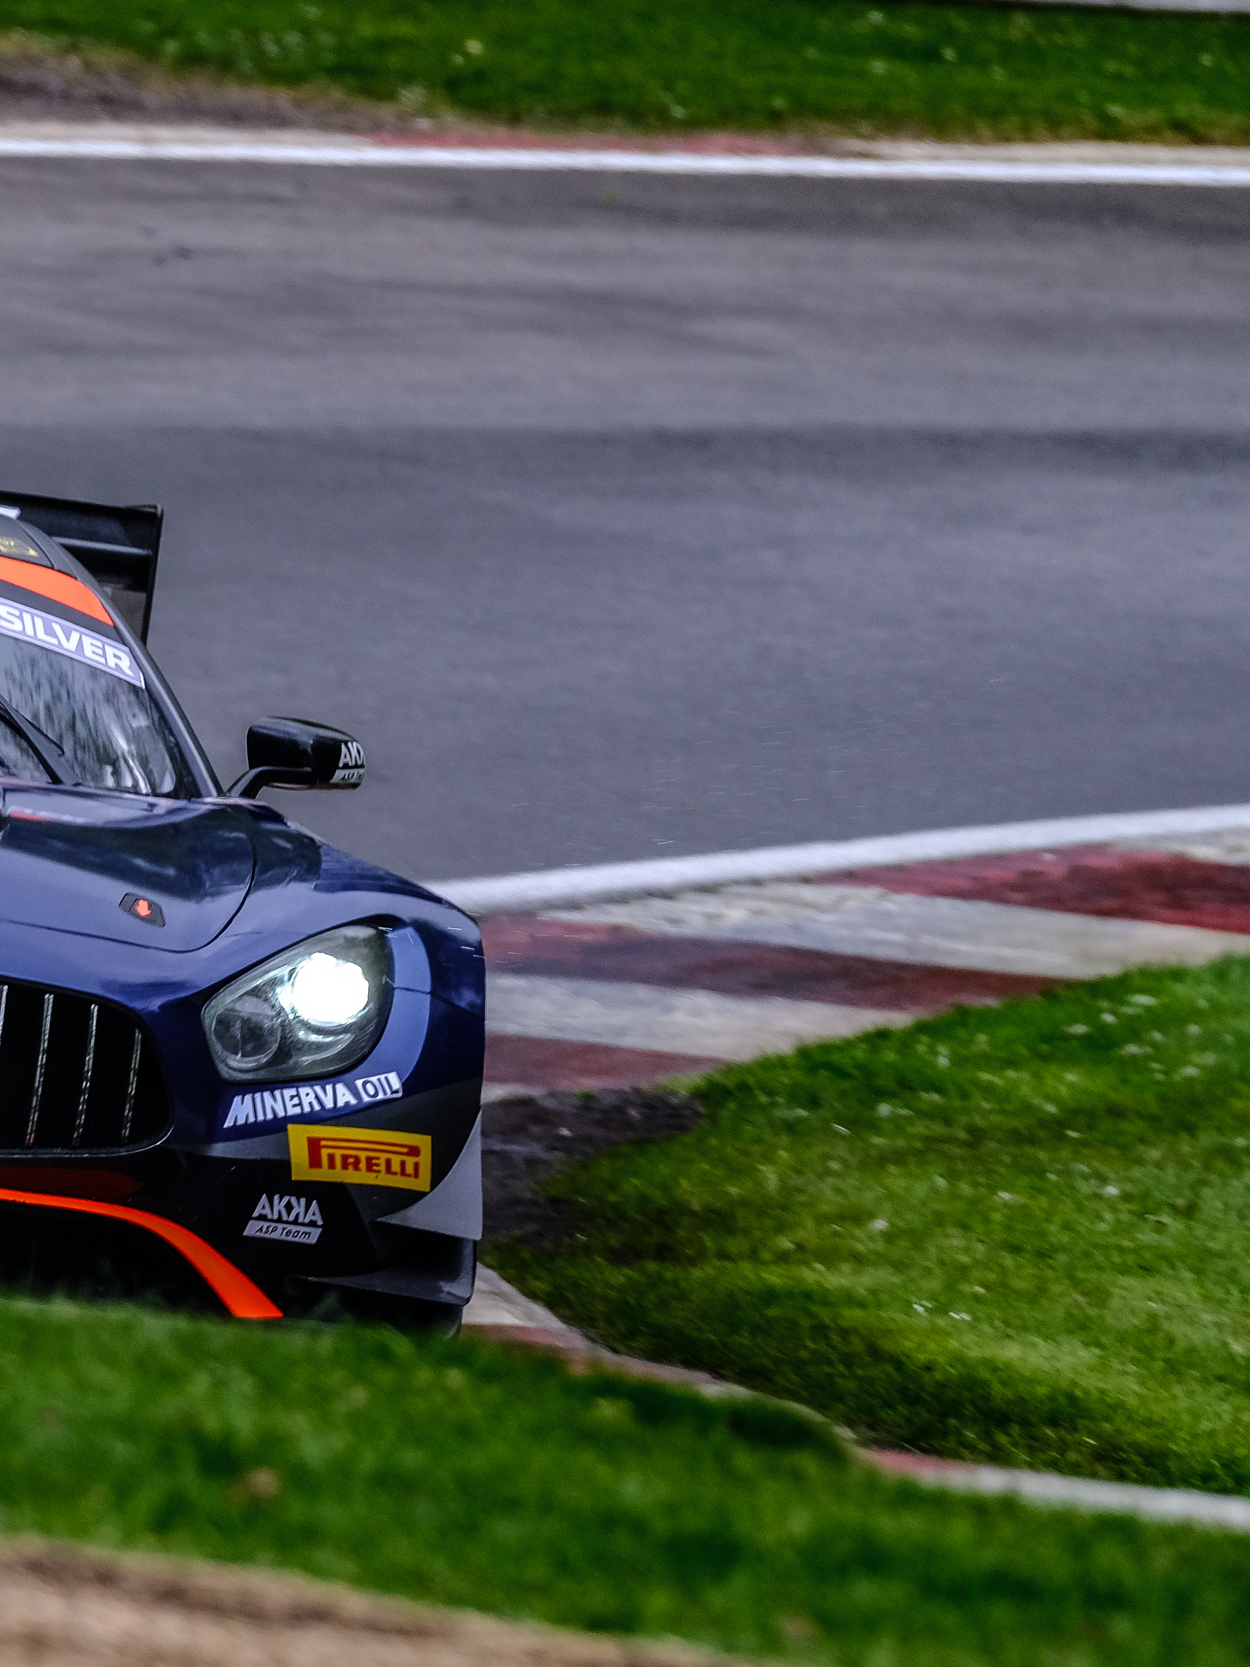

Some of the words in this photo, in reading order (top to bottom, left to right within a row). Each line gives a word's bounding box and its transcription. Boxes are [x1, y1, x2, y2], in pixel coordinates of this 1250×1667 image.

[223, 1083, 359, 1128] MINERVA
[359, 1074, 403, 1100] OIL
[306, 1136, 421, 1180] PIRELLI
[251, 1193, 324, 1225] AKKA
[255, 1222, 278, 1236] ASP
[279, 1225, 312, 1240] Team
